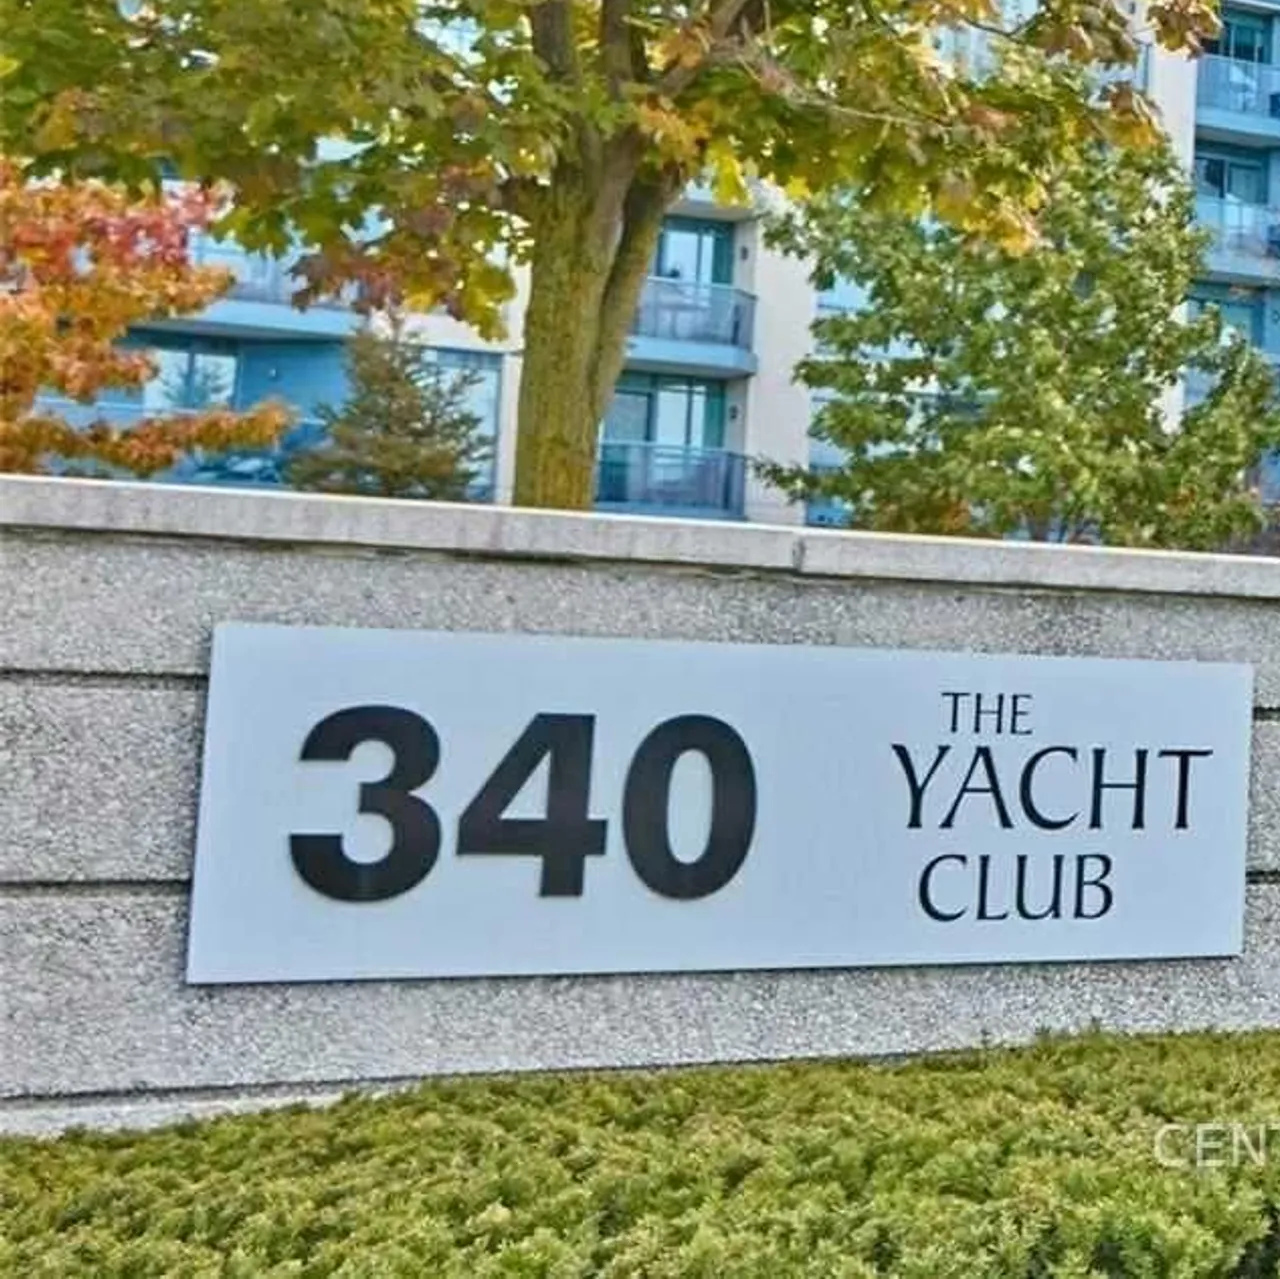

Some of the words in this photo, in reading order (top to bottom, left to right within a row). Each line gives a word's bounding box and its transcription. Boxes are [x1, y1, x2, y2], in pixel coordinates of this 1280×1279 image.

[941, 691, 1032, 735] THE
[288, 704, 759, 904] 340
[891, 743, 1214, 831] YACHT
[918, 853, 1114, 923] CLUB
